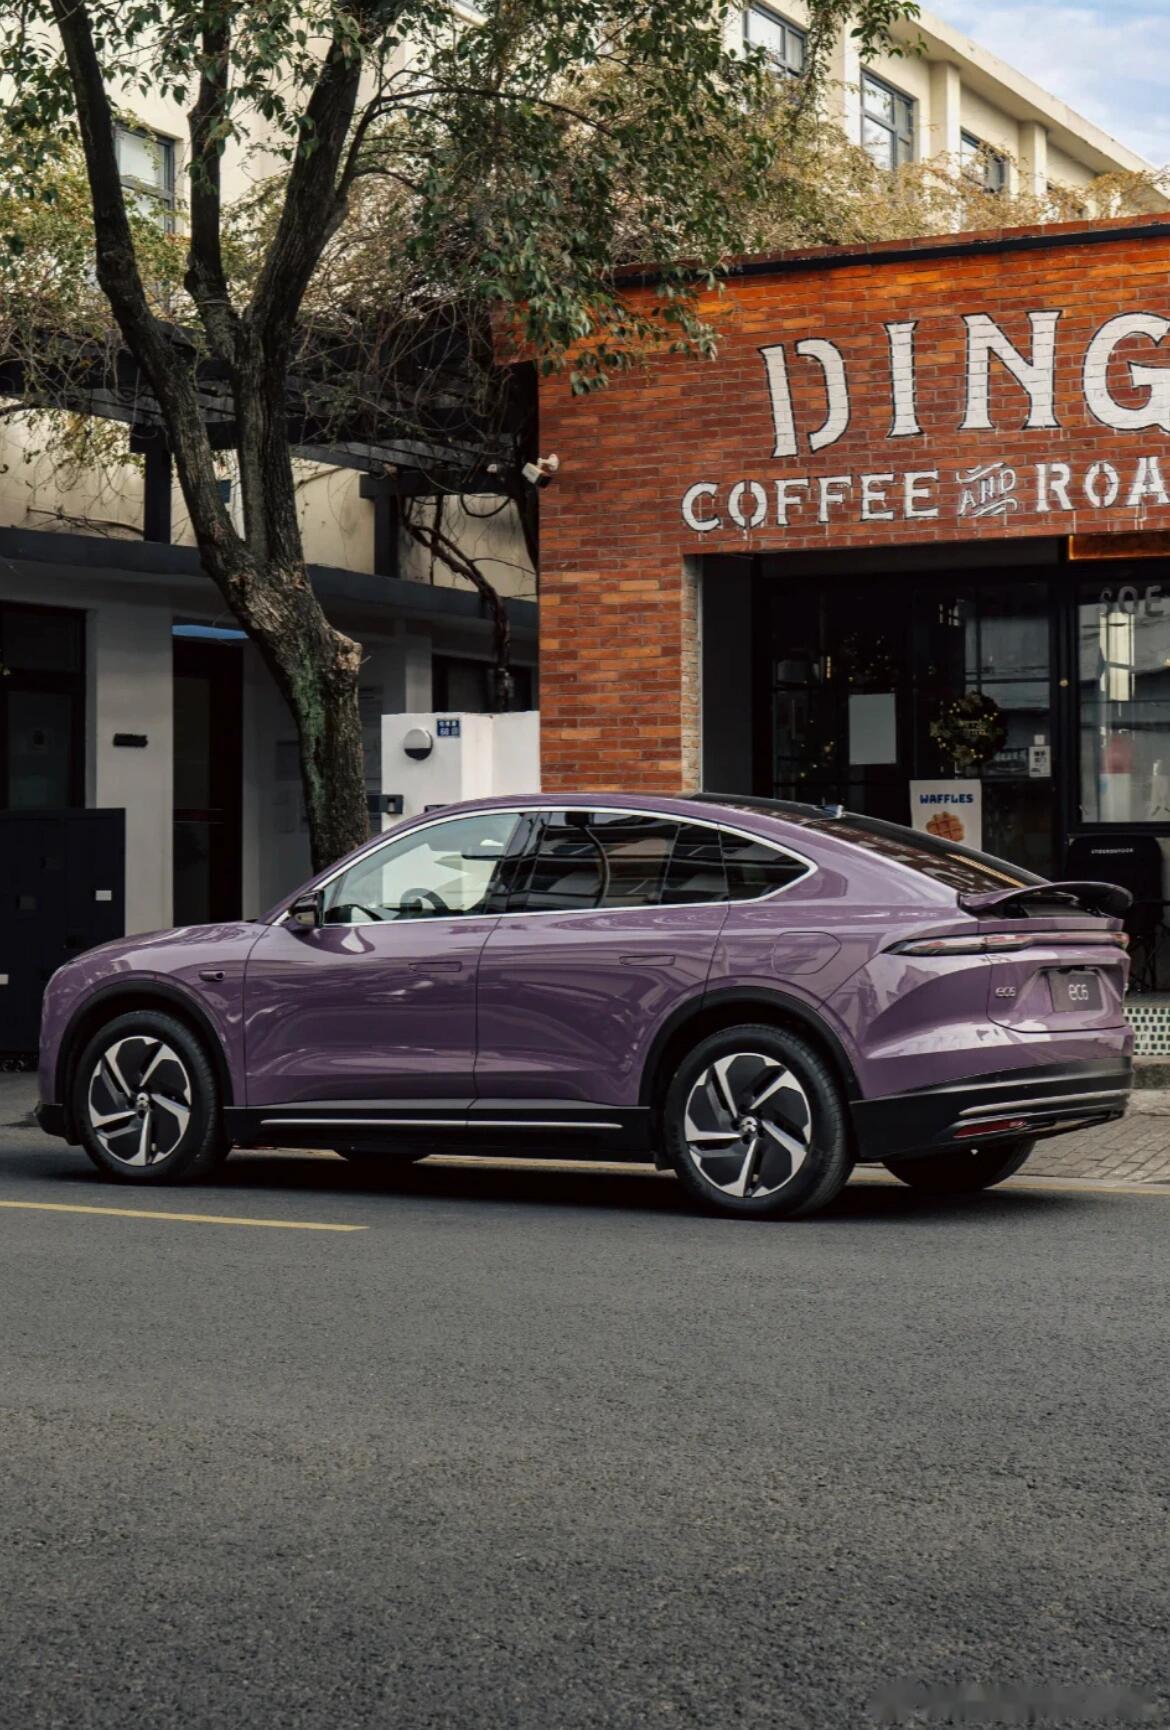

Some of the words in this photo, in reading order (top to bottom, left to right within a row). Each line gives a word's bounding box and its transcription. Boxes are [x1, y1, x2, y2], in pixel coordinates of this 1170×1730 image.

[758, 310, 1170, 458] DING
[681, 470, 940, 532] COFFEE
[1034, 456, 1170, 512] ROA
[919, 793, 974, 804] WAFFLES
